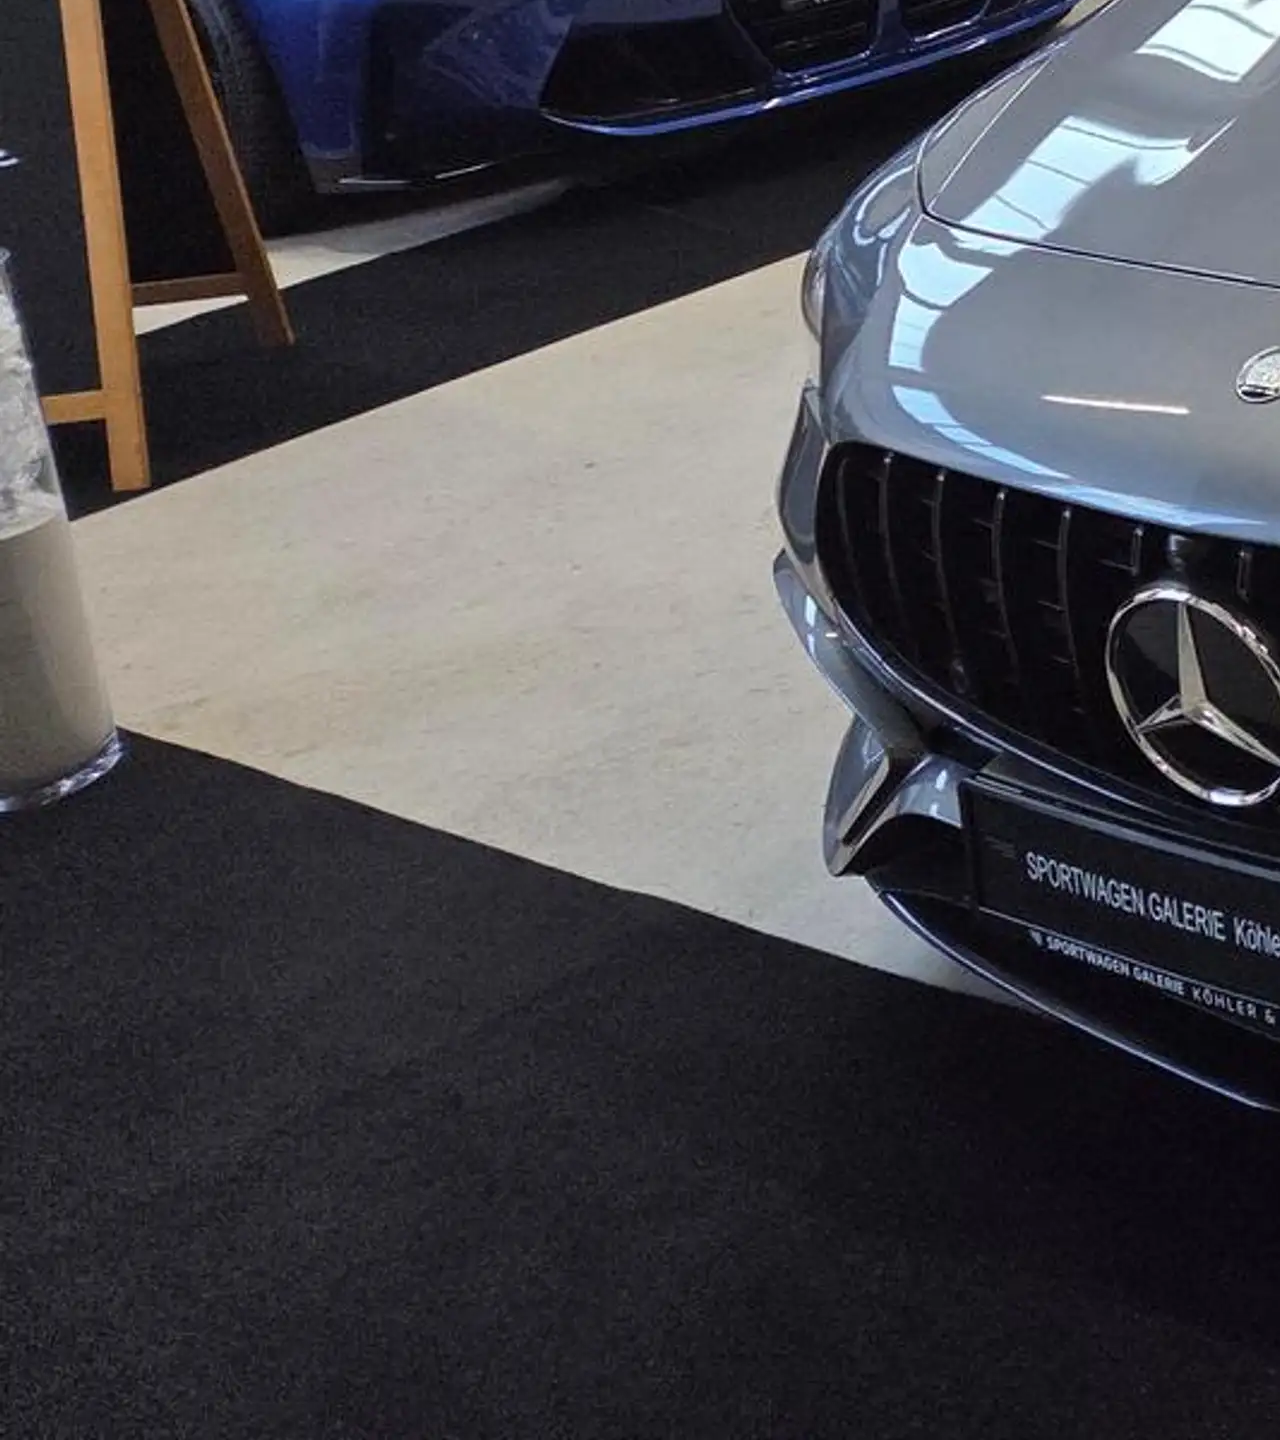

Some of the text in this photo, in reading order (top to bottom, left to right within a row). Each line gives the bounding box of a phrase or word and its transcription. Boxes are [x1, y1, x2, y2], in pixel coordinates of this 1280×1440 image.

[1026, 851, 1146, 917] SPORTWAGEN
[1148, 891, 1227, 942] GALERIE
[1045, 935, 1130, 977] SPORTWAGEN
[1131, 965, 1186, 996] GALERIE
[1192, 984, 1257, 1019] KÖHLER
[1264, 1009, 1276, 1026] &
